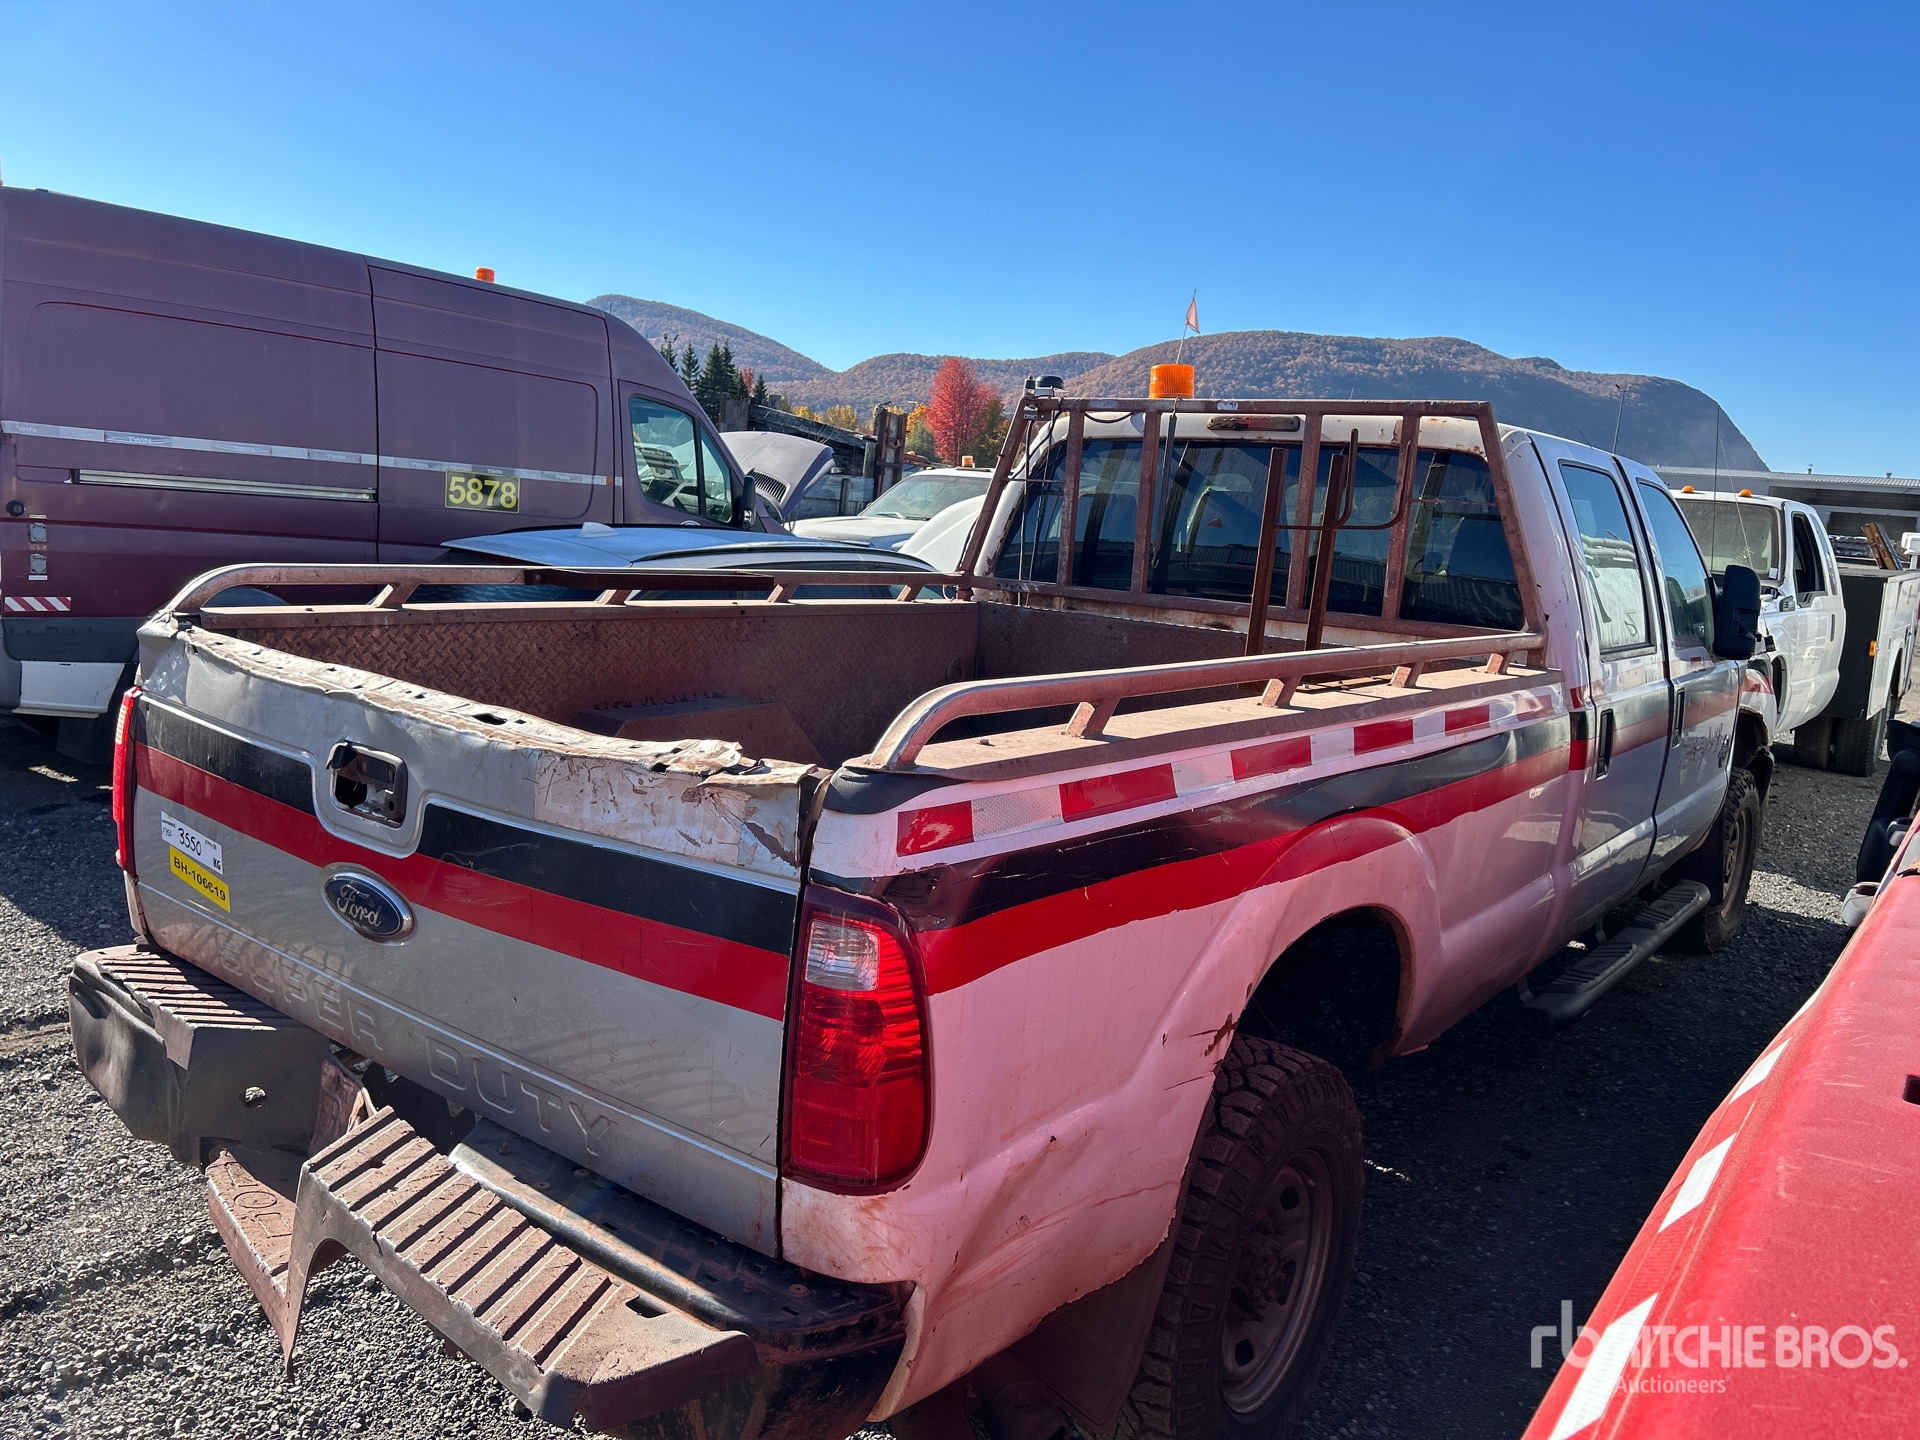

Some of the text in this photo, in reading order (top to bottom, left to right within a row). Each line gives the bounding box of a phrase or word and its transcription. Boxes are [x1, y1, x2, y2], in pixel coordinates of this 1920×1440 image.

[128, 435, 152, 444] TWIN
[232, 445, 255, 454] TWIN
[448, 476, 517, 509] 5878
[178, 828, 202, 856] 3550
[336, 884, 382, 927] Ford
[214, 932, 619, 1156] SUPER DUTY
